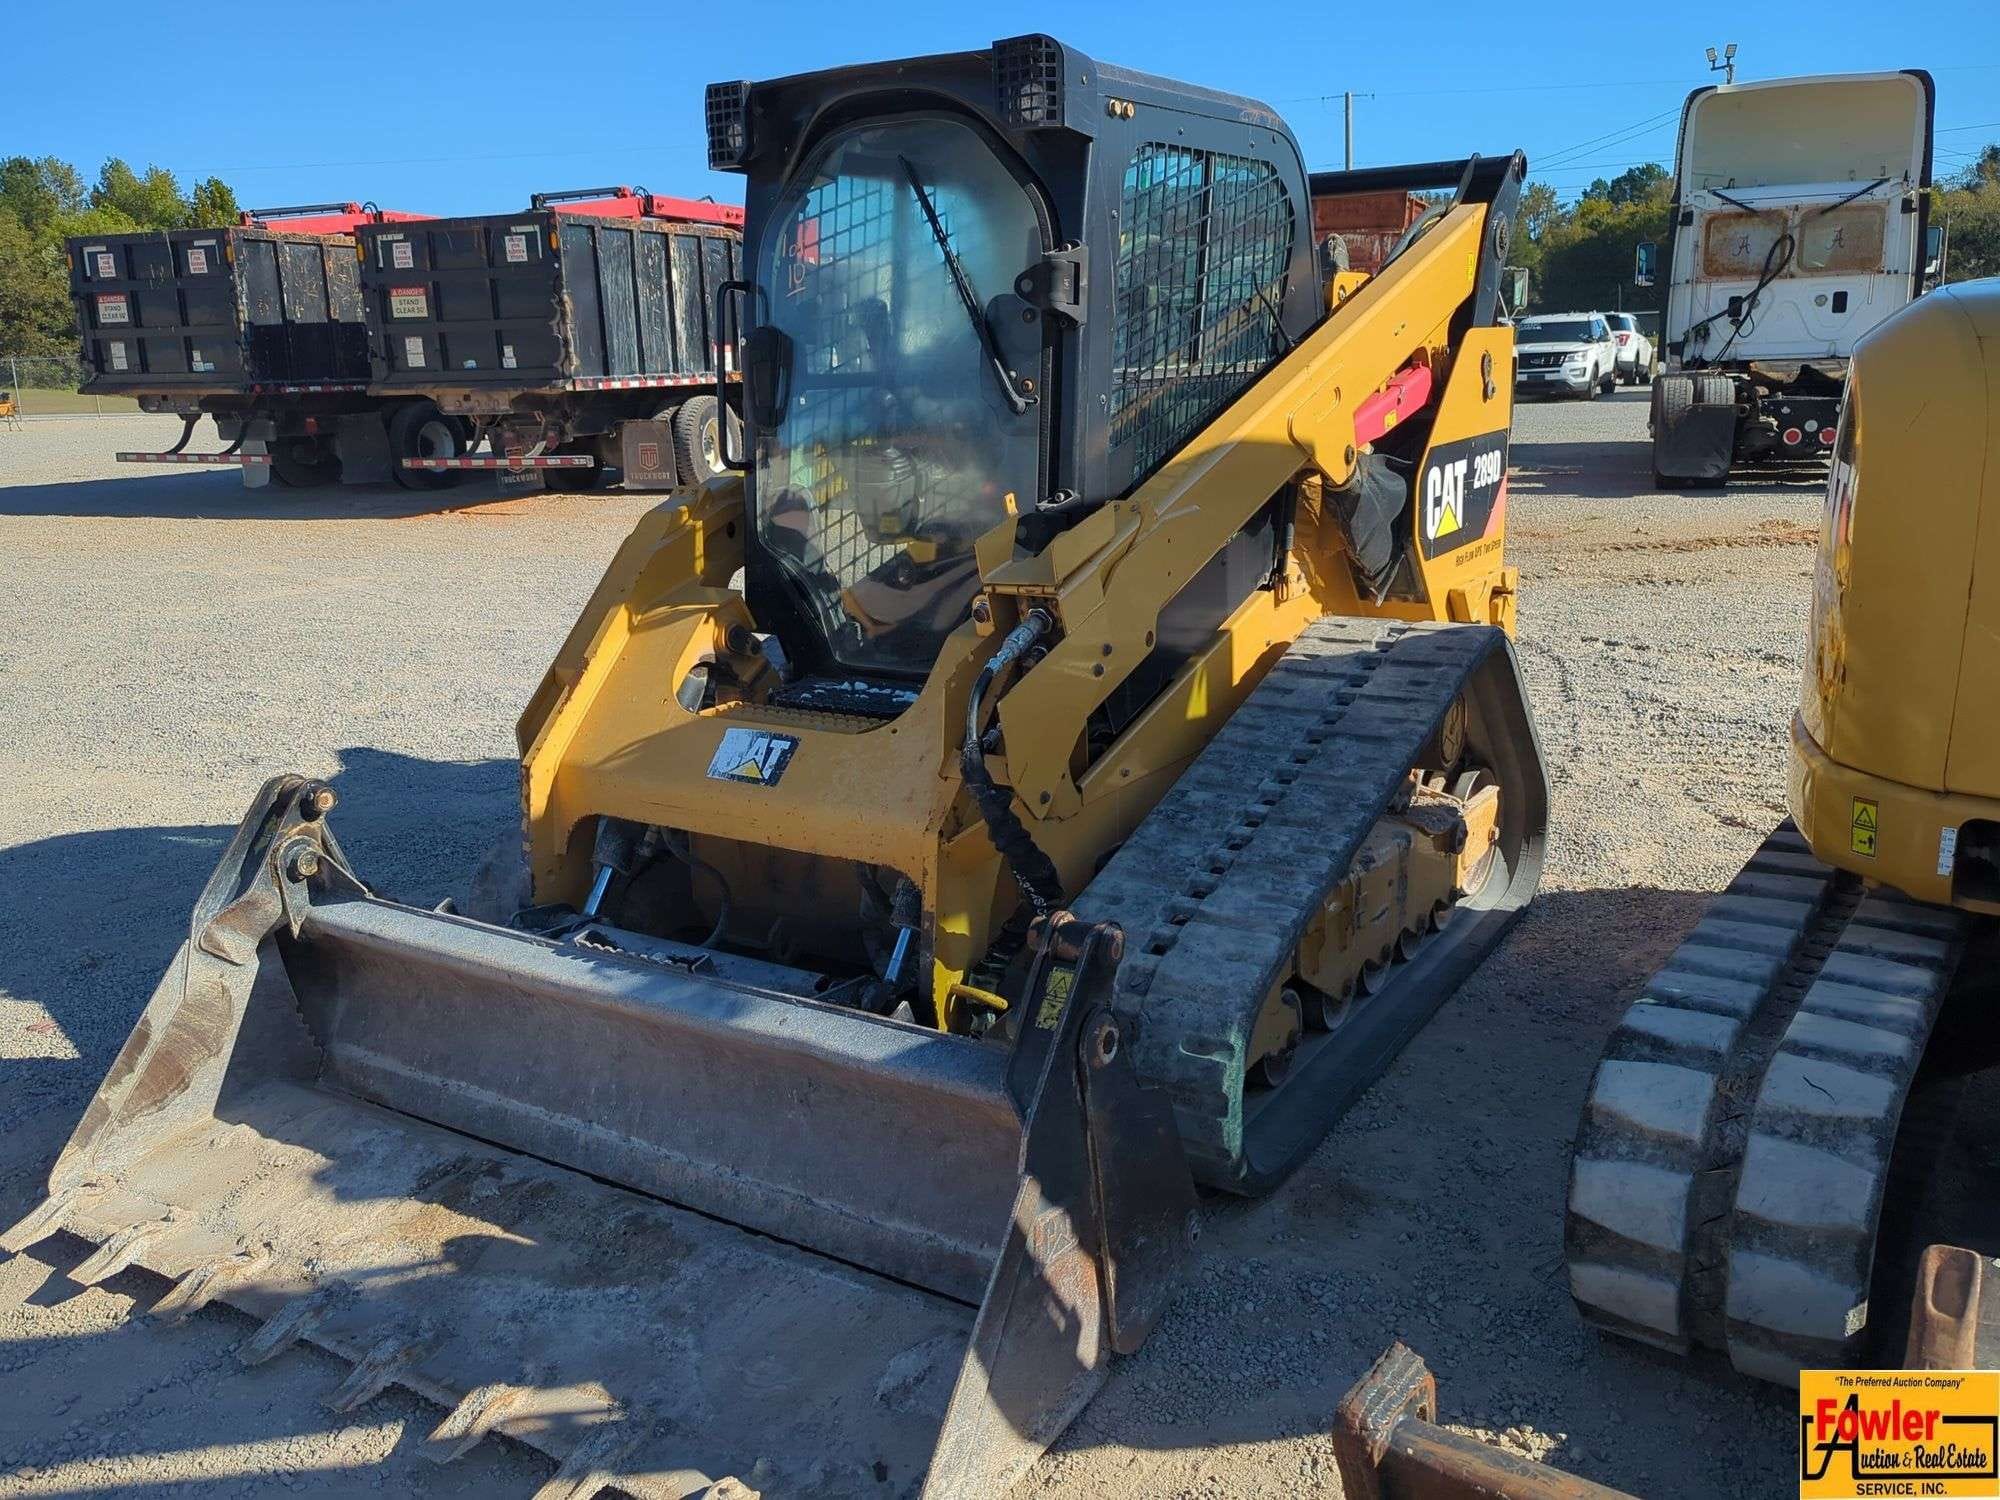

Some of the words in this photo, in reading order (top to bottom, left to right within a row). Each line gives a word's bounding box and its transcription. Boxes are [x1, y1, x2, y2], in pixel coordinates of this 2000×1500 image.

[399, 298, 419, 306] STAND
[395, 306, 415, 314] CLEAR
[1427, 459, 1467, 539] CAT
[1474, 451, 1501, 490] 289D
